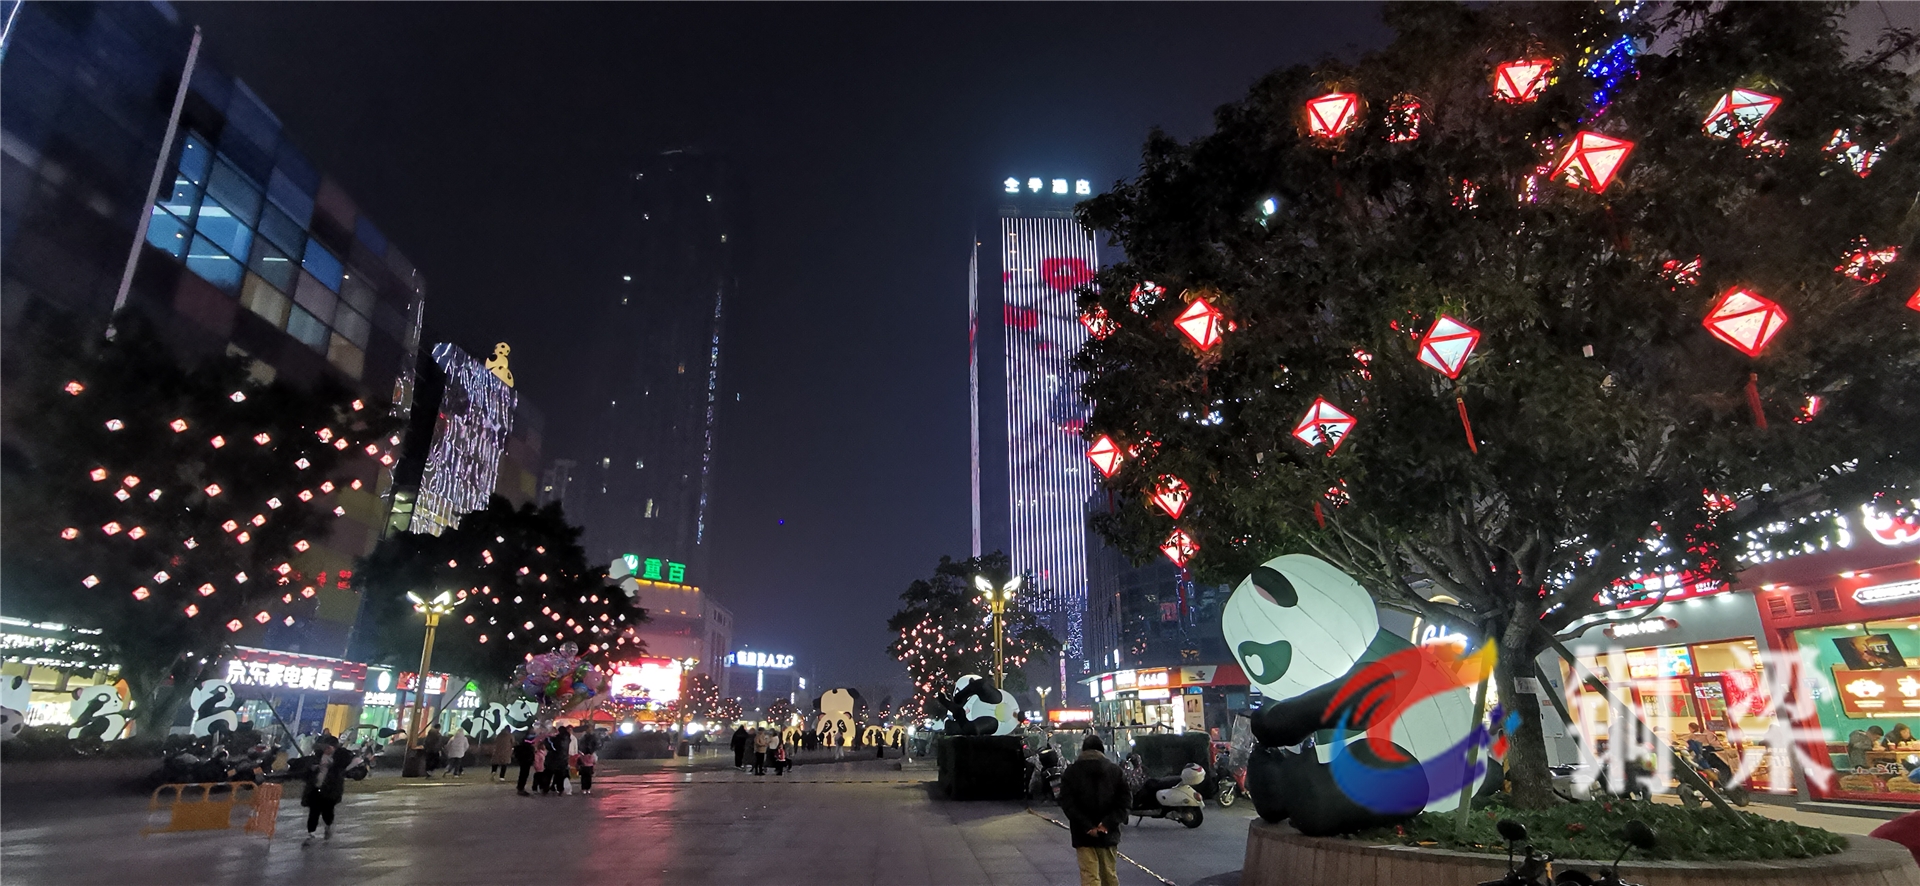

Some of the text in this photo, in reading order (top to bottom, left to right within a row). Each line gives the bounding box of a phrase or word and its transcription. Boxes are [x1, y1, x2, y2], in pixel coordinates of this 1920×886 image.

[643, 558, 686, 583] 重百
[226, 660, 333, 691] 京东家电家居
